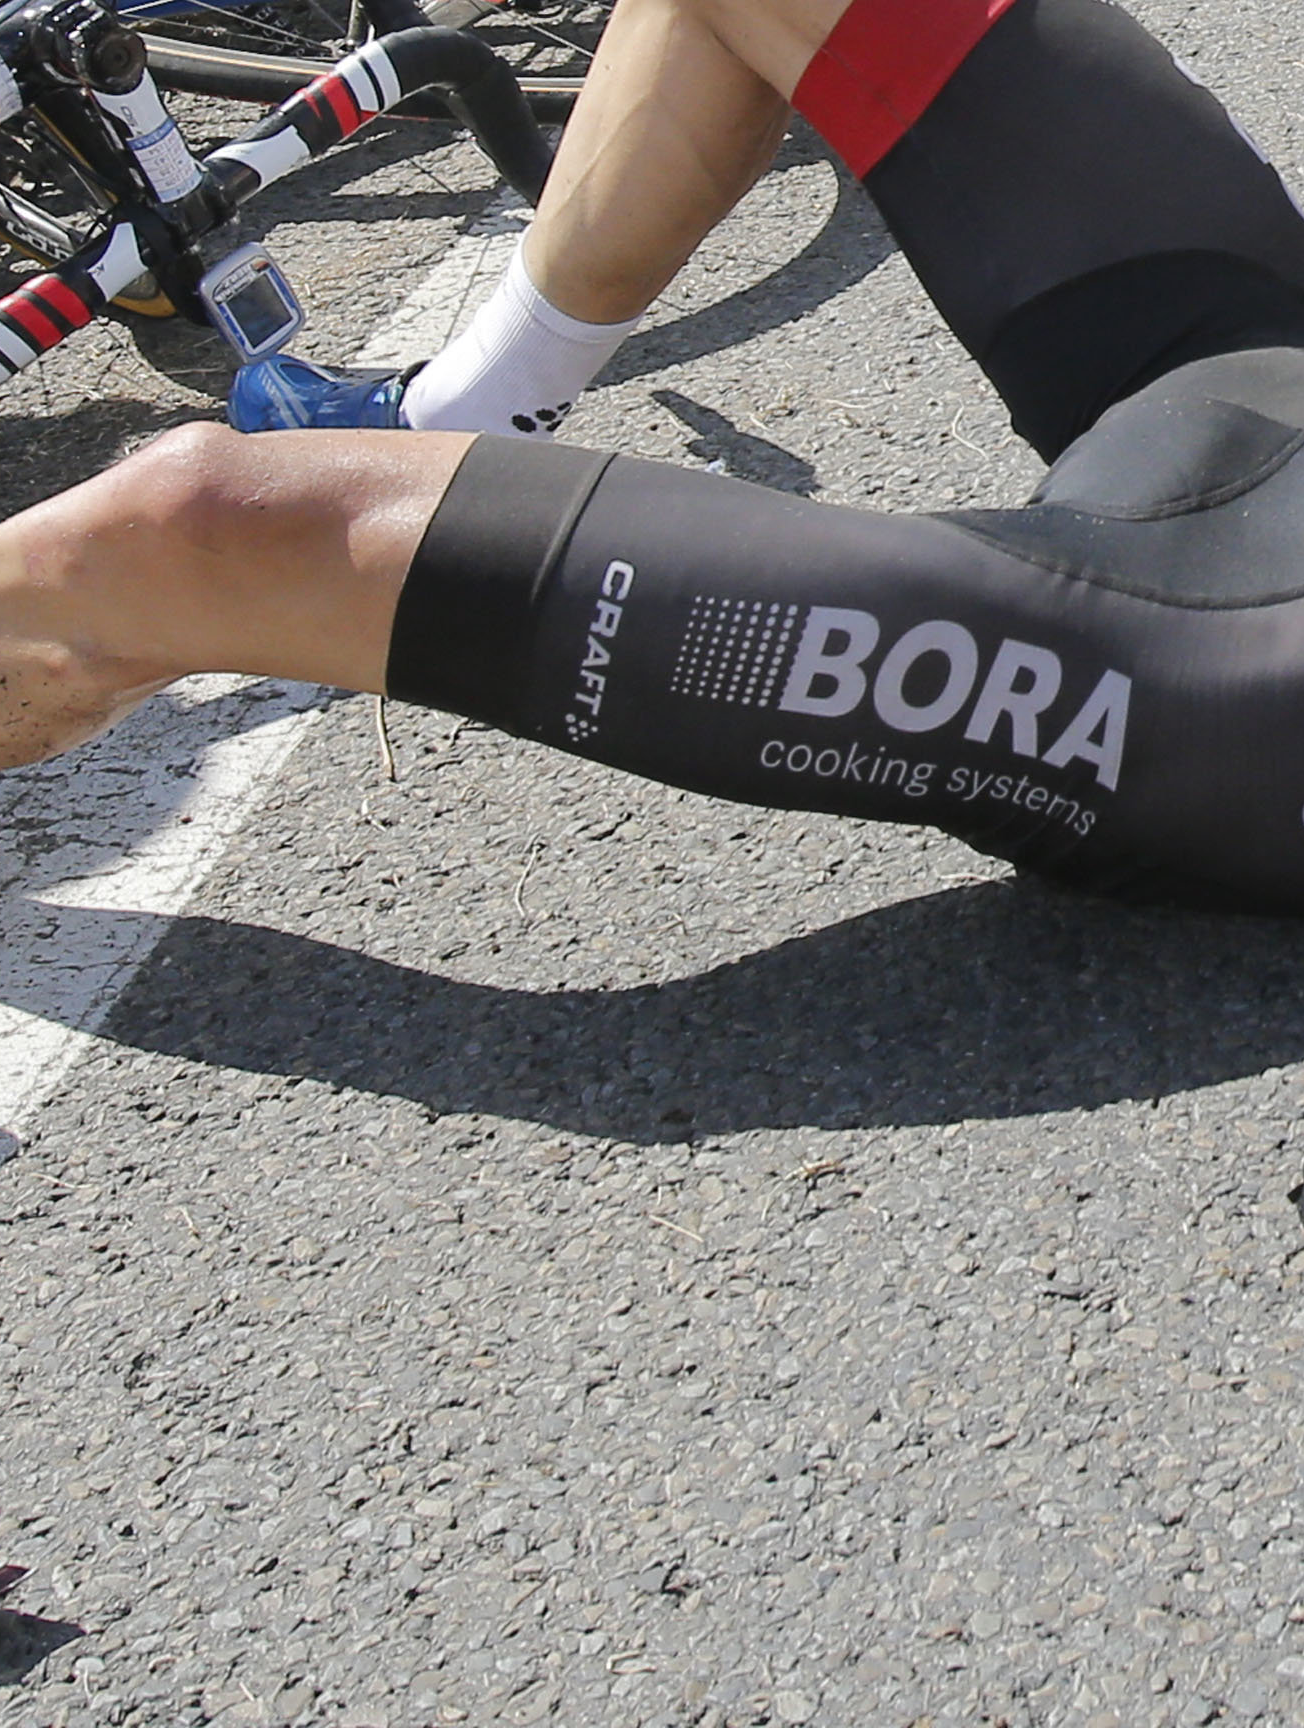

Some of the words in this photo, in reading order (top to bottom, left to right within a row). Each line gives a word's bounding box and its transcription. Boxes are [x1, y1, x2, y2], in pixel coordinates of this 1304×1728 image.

[578, 558, 635, 716] CRAFT
[780, 604, 1134, 793] BORA
[759, 736, 935, 798] cooking
[948, 765, 1097, 838] systems
